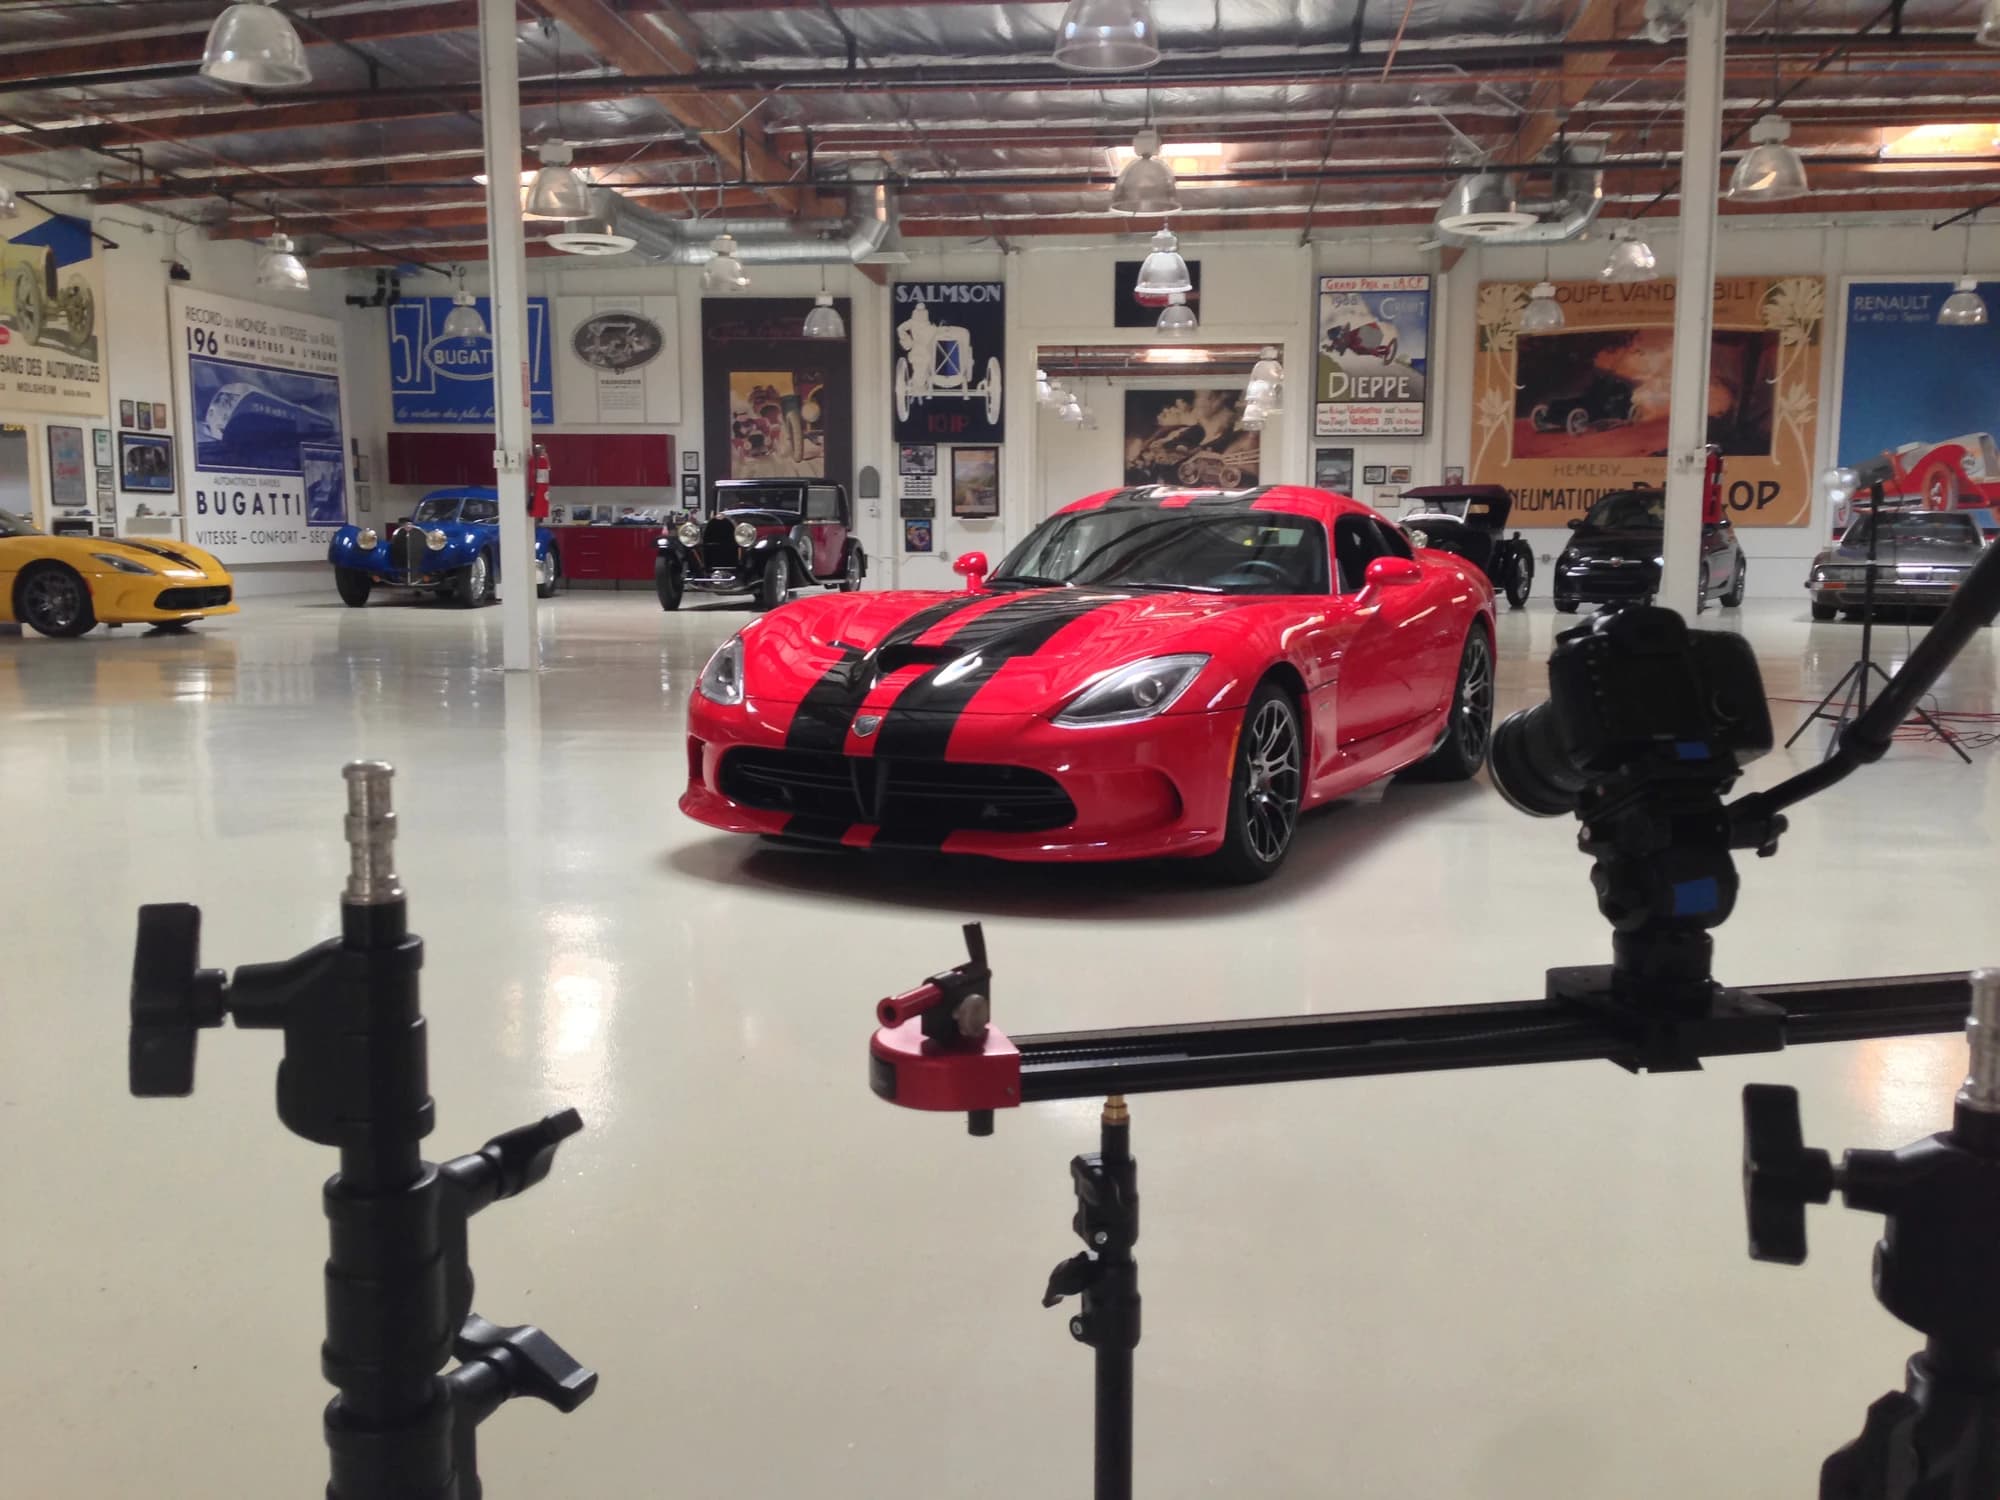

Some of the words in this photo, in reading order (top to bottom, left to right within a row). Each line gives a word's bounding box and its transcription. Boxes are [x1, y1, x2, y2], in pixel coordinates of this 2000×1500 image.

[895, 284, 1001, 303] SALMSON
[1555, 285, 1613, 304] OUPE
[1854, 295, 1931, 310] RENAULT
[185, 305, 223, 326] RECORD
[186, 326, 218, 355] 196
[434, 349, 494, 365] BUGAT
[26, 357, 42, 376] DES
[46, 360, 100, 383] AUTOMOBILES
[196, 490, 301, 515] BUGATTI
[196, 531, 237, 545] VITESSE
[250, 530, 298, 545] CONFORT
